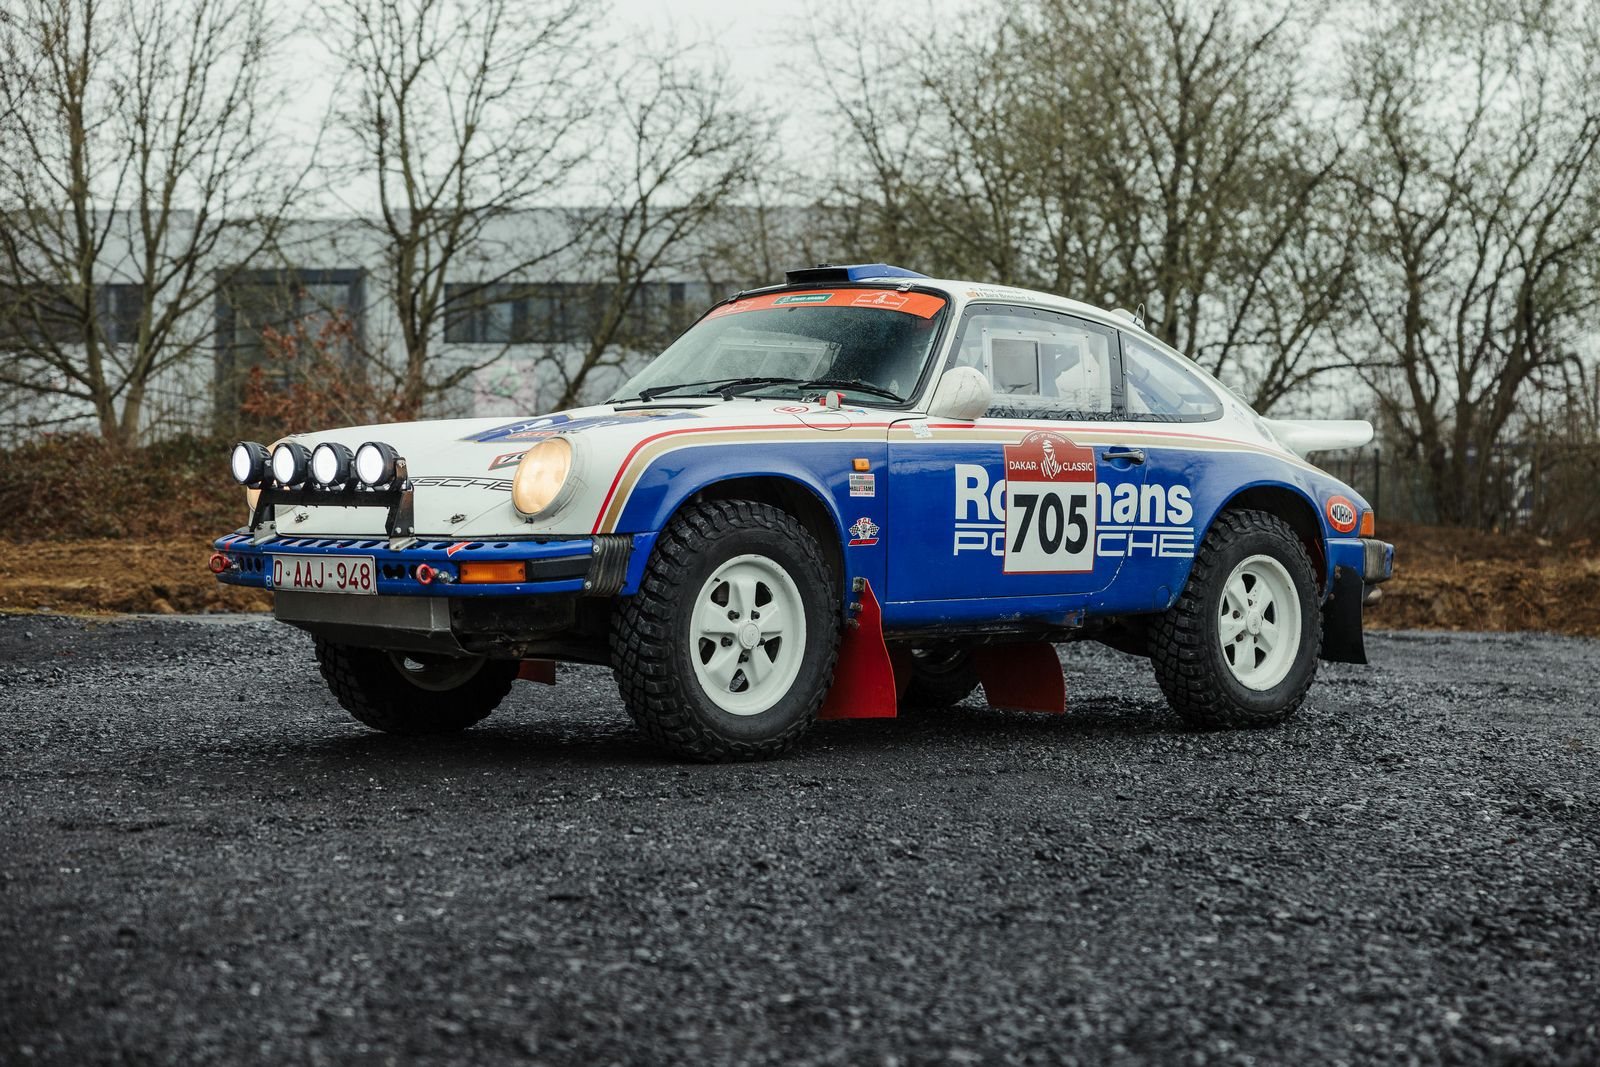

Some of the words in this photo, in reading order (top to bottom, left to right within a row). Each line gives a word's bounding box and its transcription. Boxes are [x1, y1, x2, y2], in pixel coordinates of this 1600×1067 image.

[1009, 460, 1037, 471] DAKAR
[1062, 462, 1093, 472] CLASSIC
[955, 463, 1194, 525] Roans
[1011, 492, 1089, 555] 705
[953, 531, 1195, 558] PCHE
